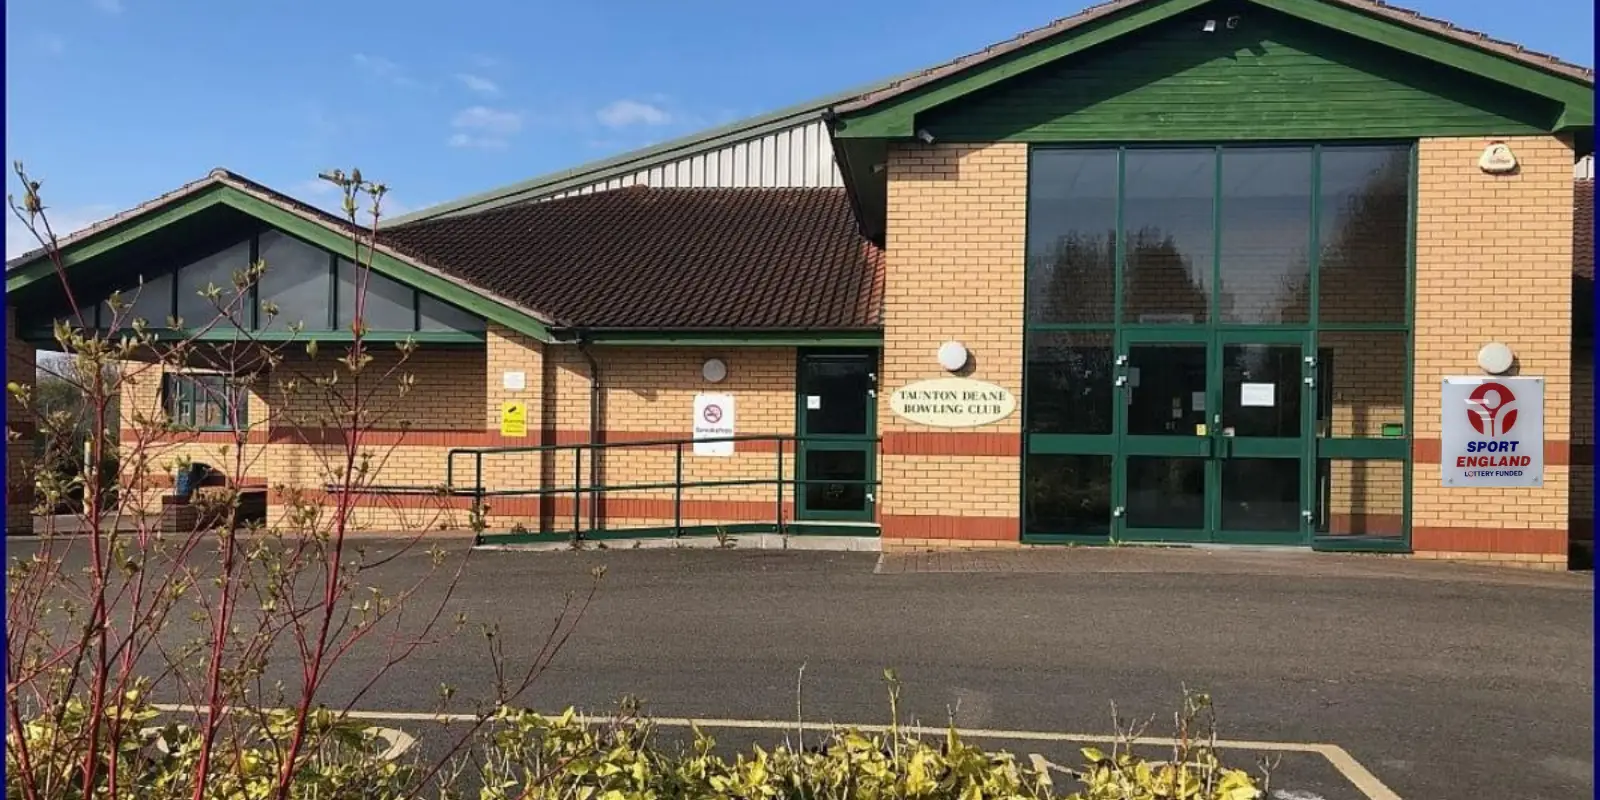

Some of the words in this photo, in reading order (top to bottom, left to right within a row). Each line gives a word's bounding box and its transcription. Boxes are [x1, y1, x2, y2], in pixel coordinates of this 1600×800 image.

[900, 390, 957, 400] TAUNTON
[963, 391, 1006, 401] DEANE
[904, 404, 963, 414] BOWLING
[968, 405, 1001, 414] CLUB
[1467, 441, 1519, 452] SPORT
[1456, 456, 1531, 467] ENGLAND
